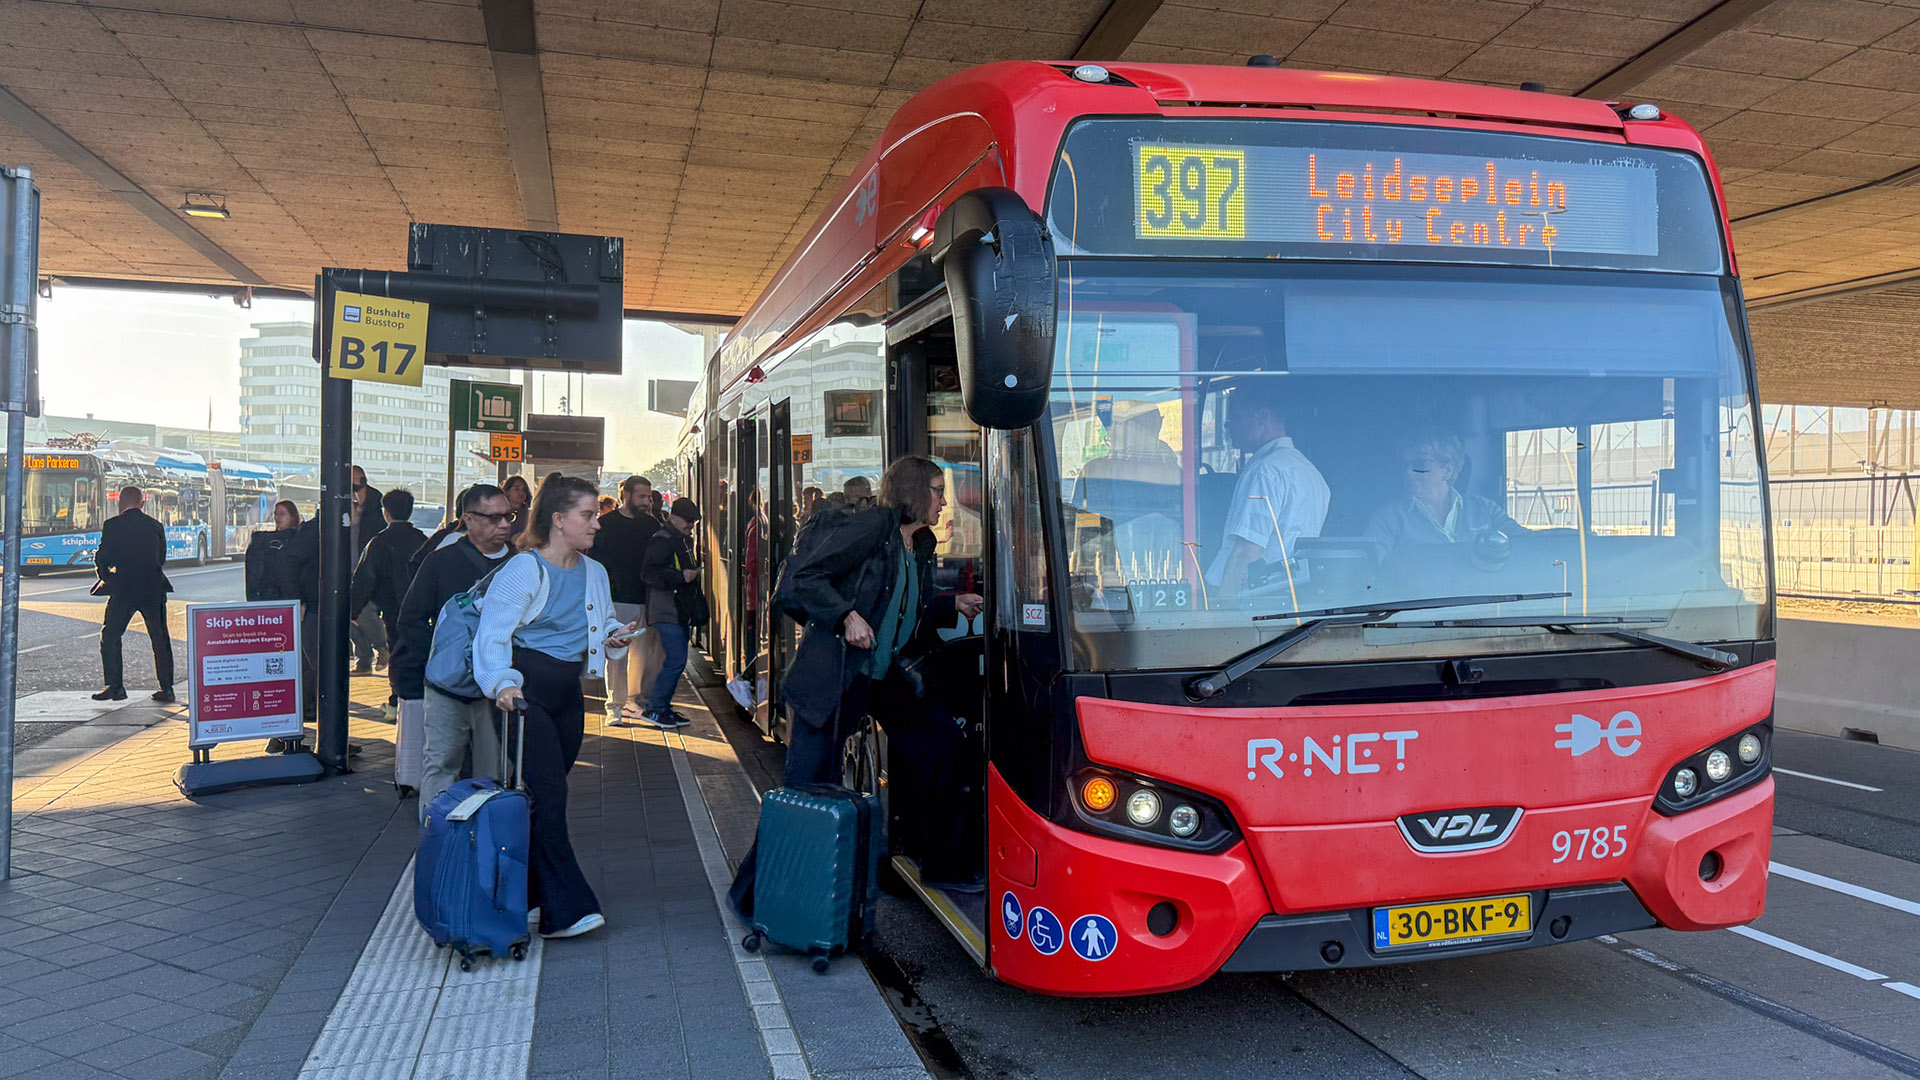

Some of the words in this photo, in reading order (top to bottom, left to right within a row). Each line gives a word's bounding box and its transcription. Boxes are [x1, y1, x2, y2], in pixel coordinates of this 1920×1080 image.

[1309, 154, 1566, 208] Leidseplein
[1145, 154, 1240, 231] 397
[1317, 204, 1402, 243] City
[1426, 207, 1558, 247] Centre
[366, 306, 411, 320] Bushalte
[365, 316, 405, 331] Busstop
[339, 336, 417, 376] B17
[493, 446, 520, 459] B15
[46, 455, 79, 469] Parkeren
[62, 537, 97, 547] Schiphol
[1025, 608, 1043, 620] SCZ
[206, 617, 233, 629] Skip
[234, 616, 255, 627] the
[258, 615, 283, 626] line!
[207, 638, 239, 646] Amsterdam
[1417, 813, 1499, 840] VDL
[1552, 825, 1628, 863] 9785
[1398, 902, 1519, 939] 30-BKF-9
[1376, 931, 1388, 940] NL
